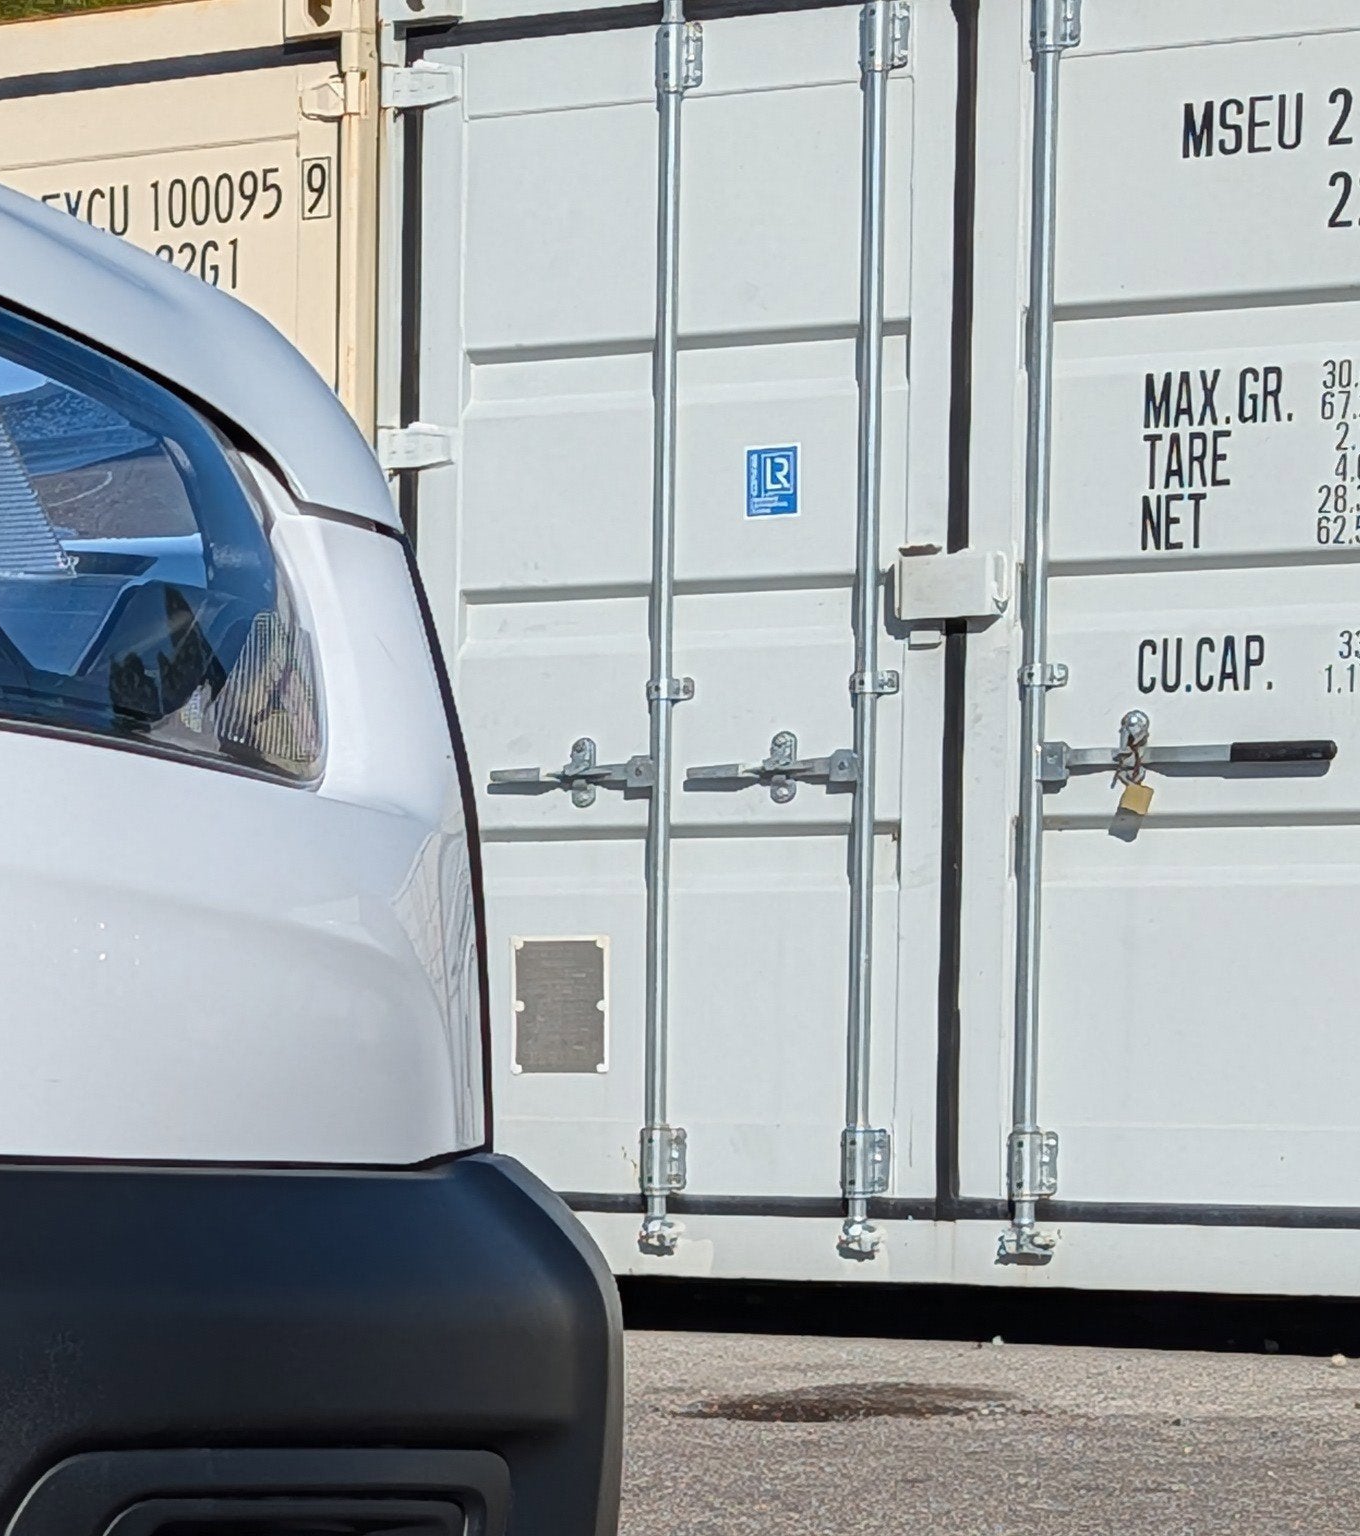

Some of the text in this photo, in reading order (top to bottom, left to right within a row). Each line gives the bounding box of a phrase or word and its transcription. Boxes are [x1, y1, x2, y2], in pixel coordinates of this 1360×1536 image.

[1182, 87, 1353, 158] MSEU 2
[41, 163, 327, 236] XCU 100095 9
[1327, 171, 1360, 228] 2
[1321, 391, 1360, 420] 67.
[766, 457, 790, 490] LR
[1143, 430, 1232, 490] TARE
[1335, 453, 1360, 481] 4.
[1141, 493, 1207, 550] NET
